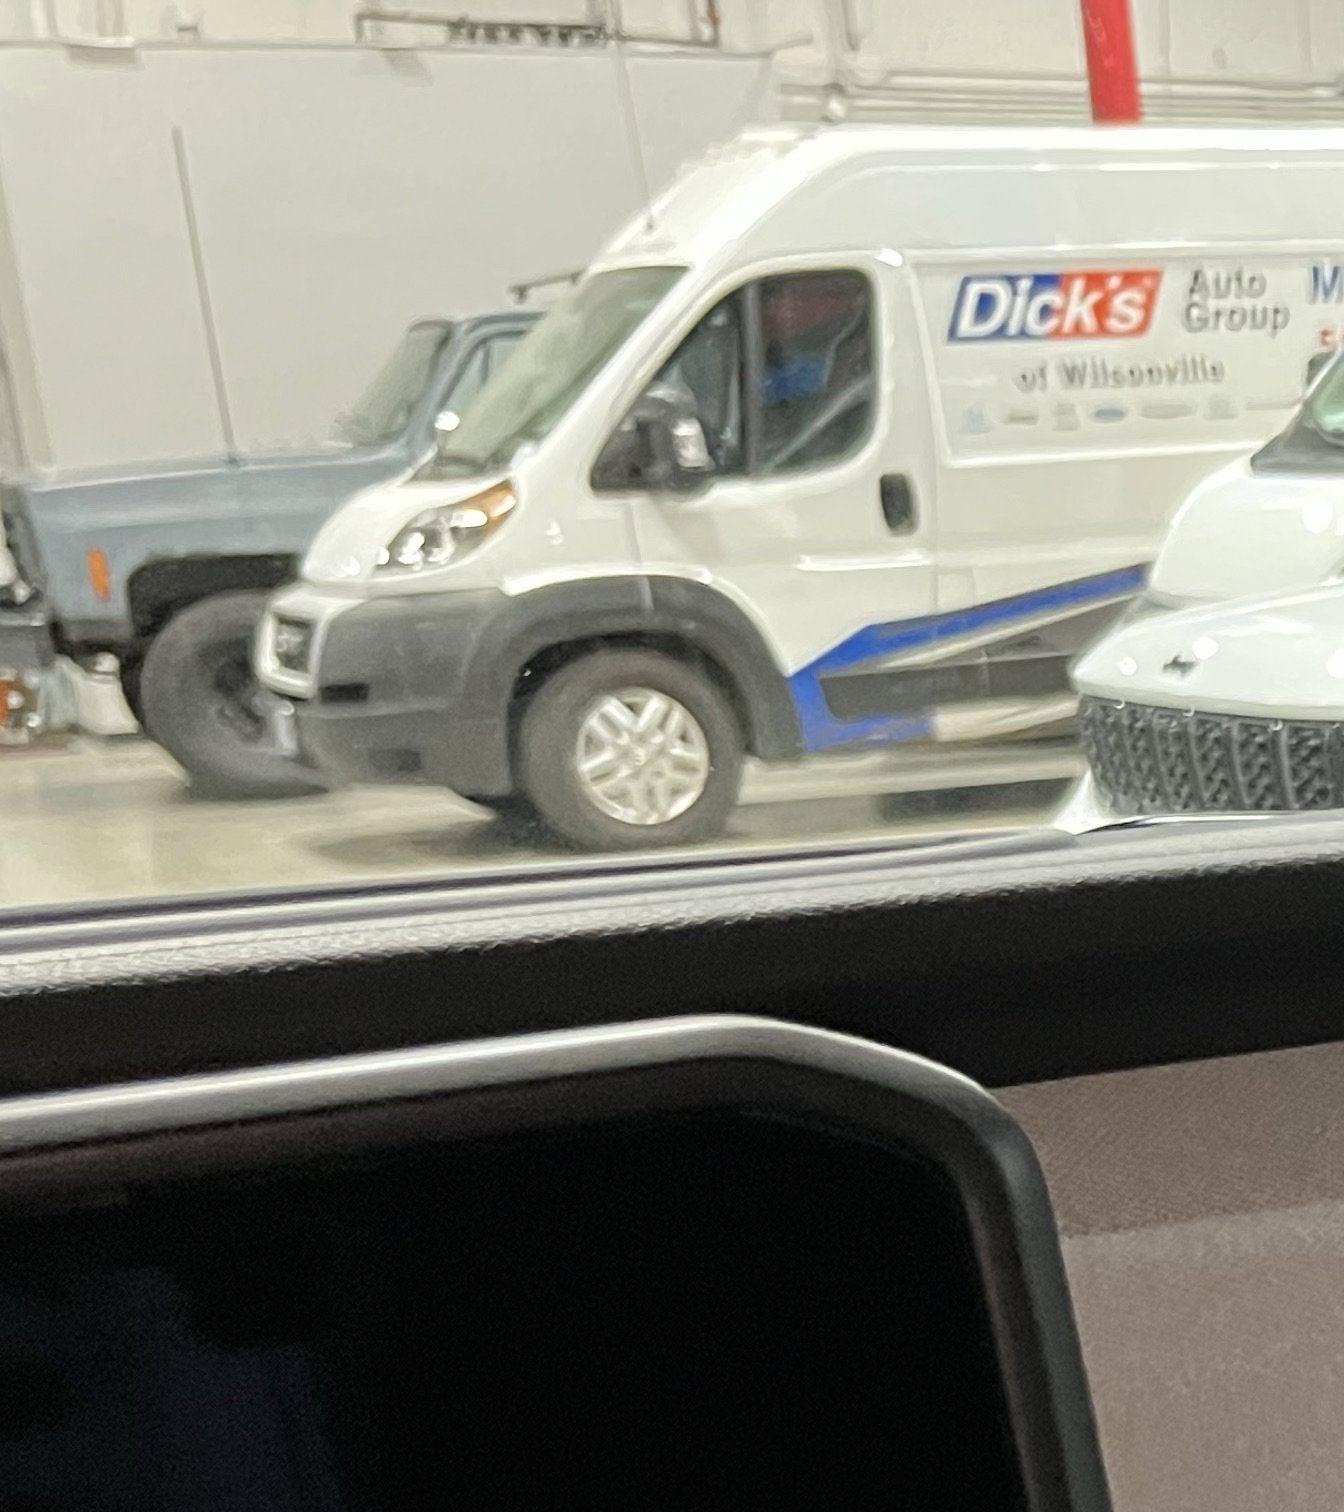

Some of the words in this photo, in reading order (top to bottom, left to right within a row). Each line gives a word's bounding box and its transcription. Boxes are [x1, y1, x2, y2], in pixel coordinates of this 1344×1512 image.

[1188, 268, 1268, 301] Auto
[1182, 302, 1290, 339] Group
[1013, 365, 1048, 393] of
[1061, 355, 1226, 391] Wilsonville
